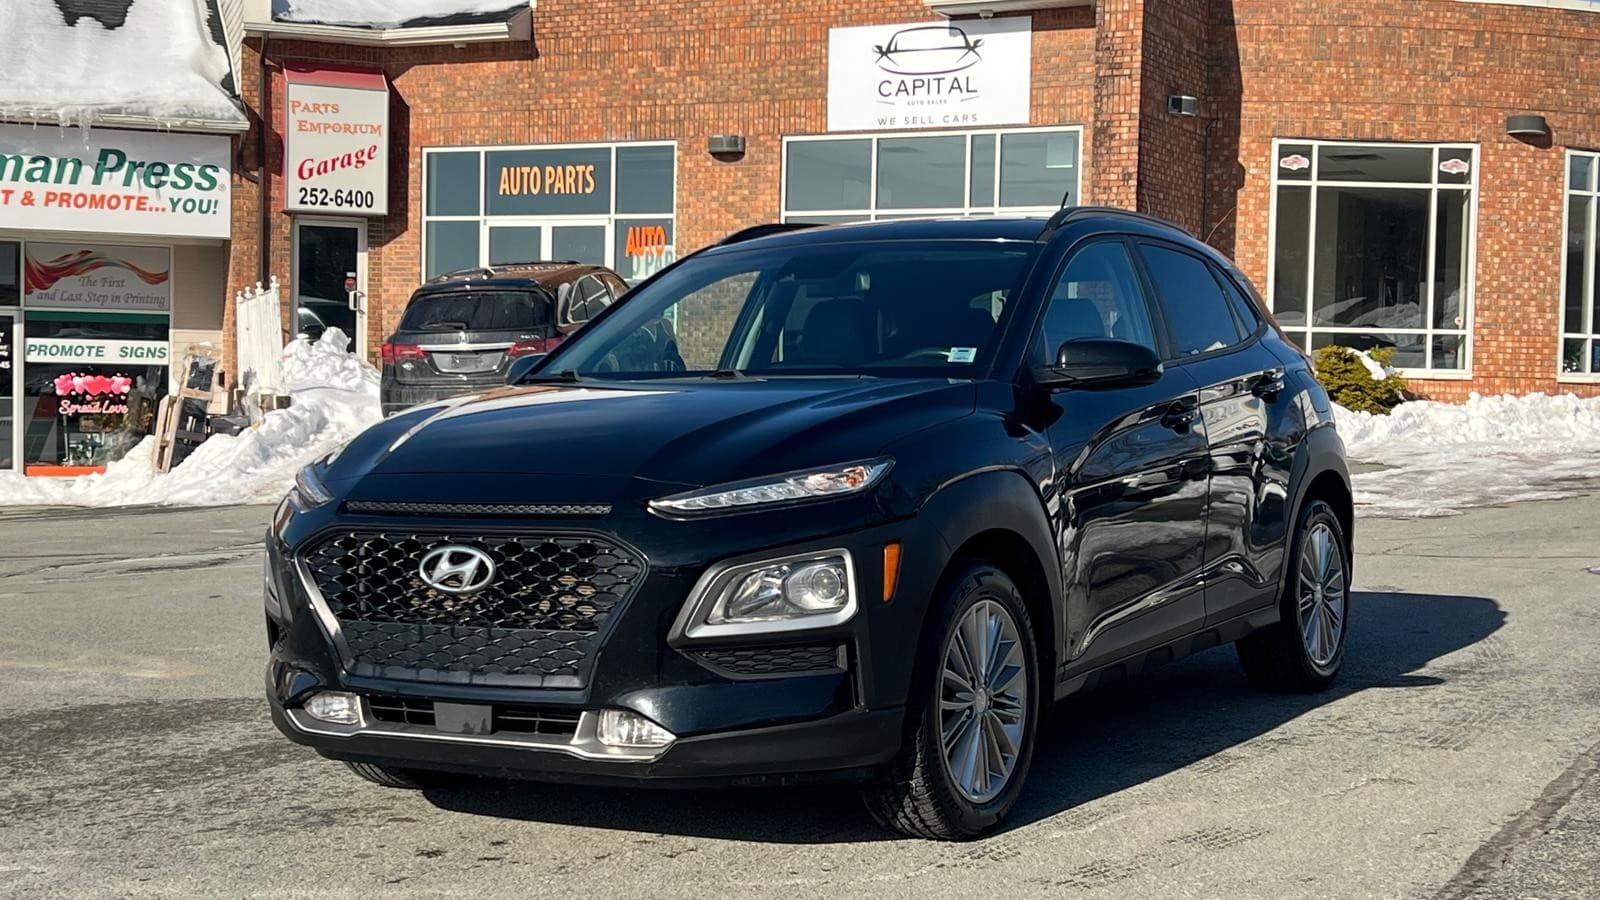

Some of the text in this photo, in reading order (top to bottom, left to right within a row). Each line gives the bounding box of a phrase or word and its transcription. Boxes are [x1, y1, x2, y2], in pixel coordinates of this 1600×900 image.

[878, 76, 978, 97] CAPITAL
[878, 113, 978, 126] WE SELL CARS
[92, 148, 219, 191] Press
[297, 144, 378, 181] Garage
[499, 164, 596, 195] AUTO PARTS
[20, 191, 36, 207] &
[298, 187, 374, 208] 252-6400
[624, 224, 667, 257] AUTO
[79, 276, 125, 288] The First
[36, 288, 166, 308] and Last Step in Printing
[26, 344, 167, 359] PROMOTE SIGNS
[58, 399, 129, 416] Spread Love
